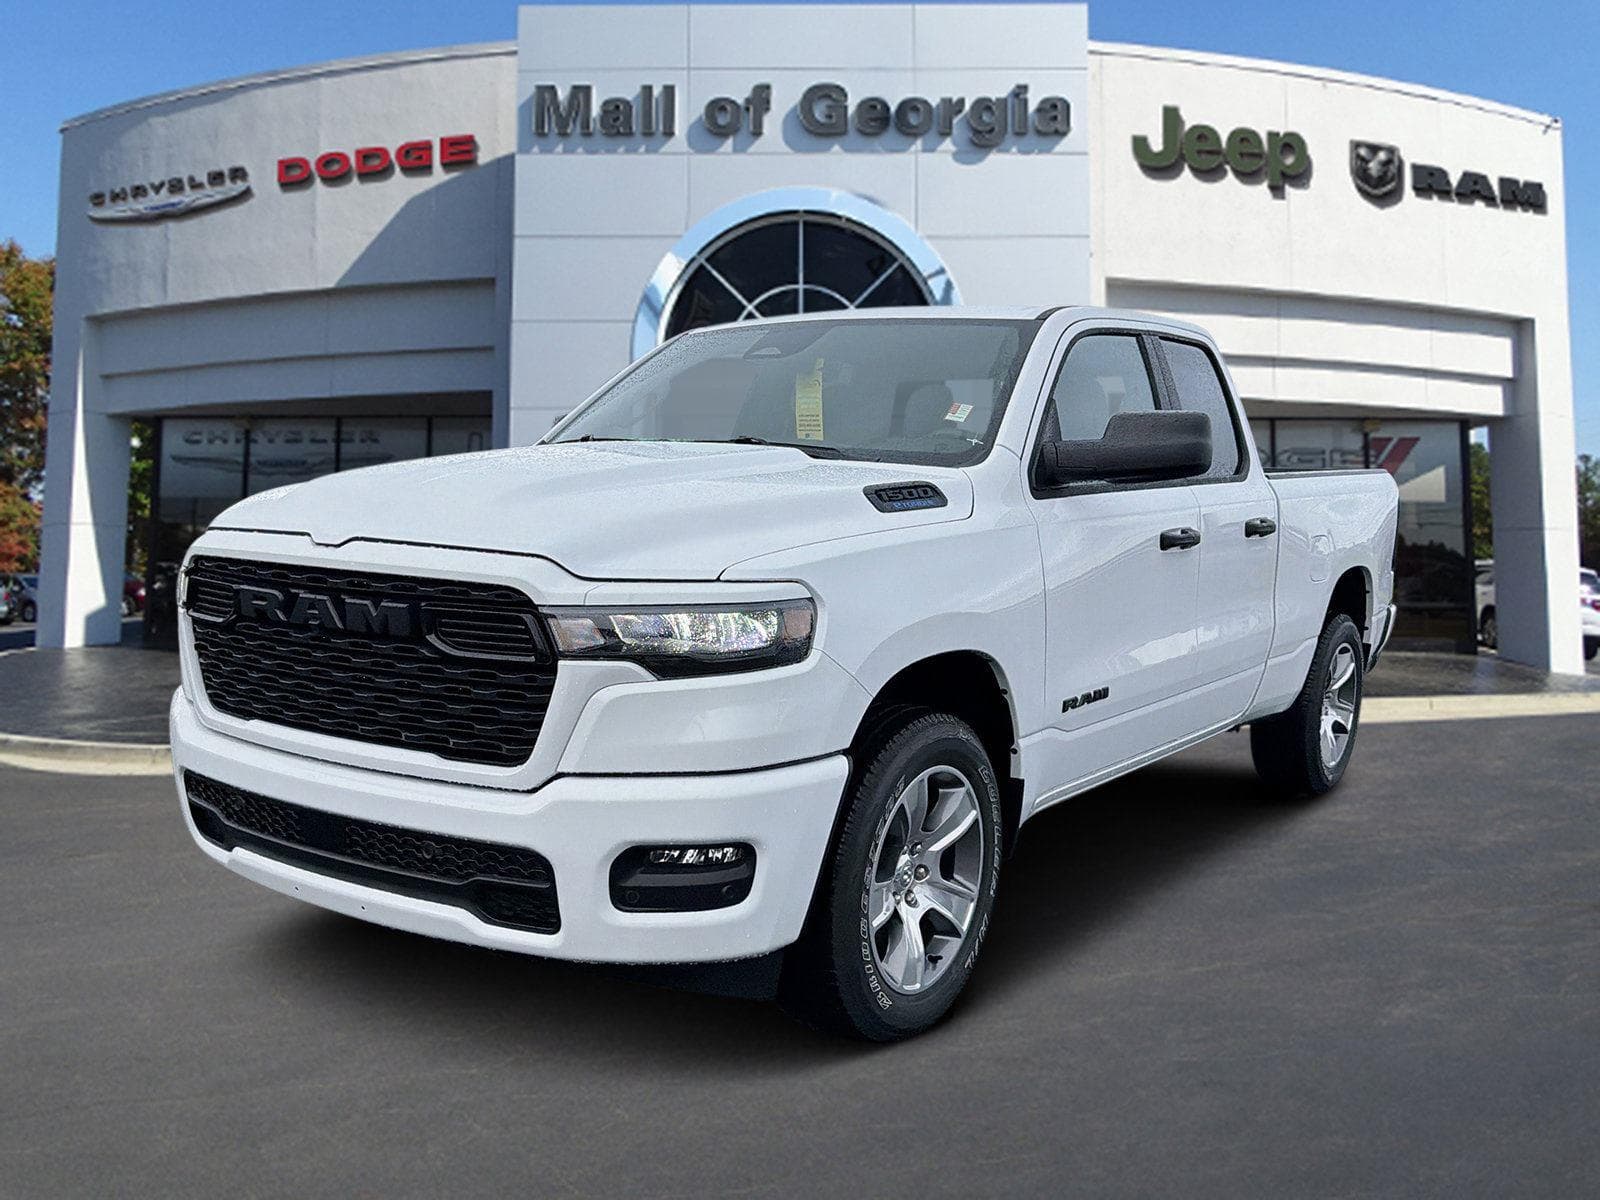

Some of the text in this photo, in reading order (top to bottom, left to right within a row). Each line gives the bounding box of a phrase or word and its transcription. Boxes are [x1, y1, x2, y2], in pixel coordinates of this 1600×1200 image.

[532, 83, 1073, 148] Mall of Georgia
[277, 134, 477, 189] DODGE
[1131, 105, 1311, 194] Jeep
[89, 166, 248, 207] CHRYSLER
[1410, 163, 1547, 213] RAM
[877, 487, 932, 503] 1500
[233, 584, 410, 636] RAM
[1062, 686, 1109, 713] RAM
